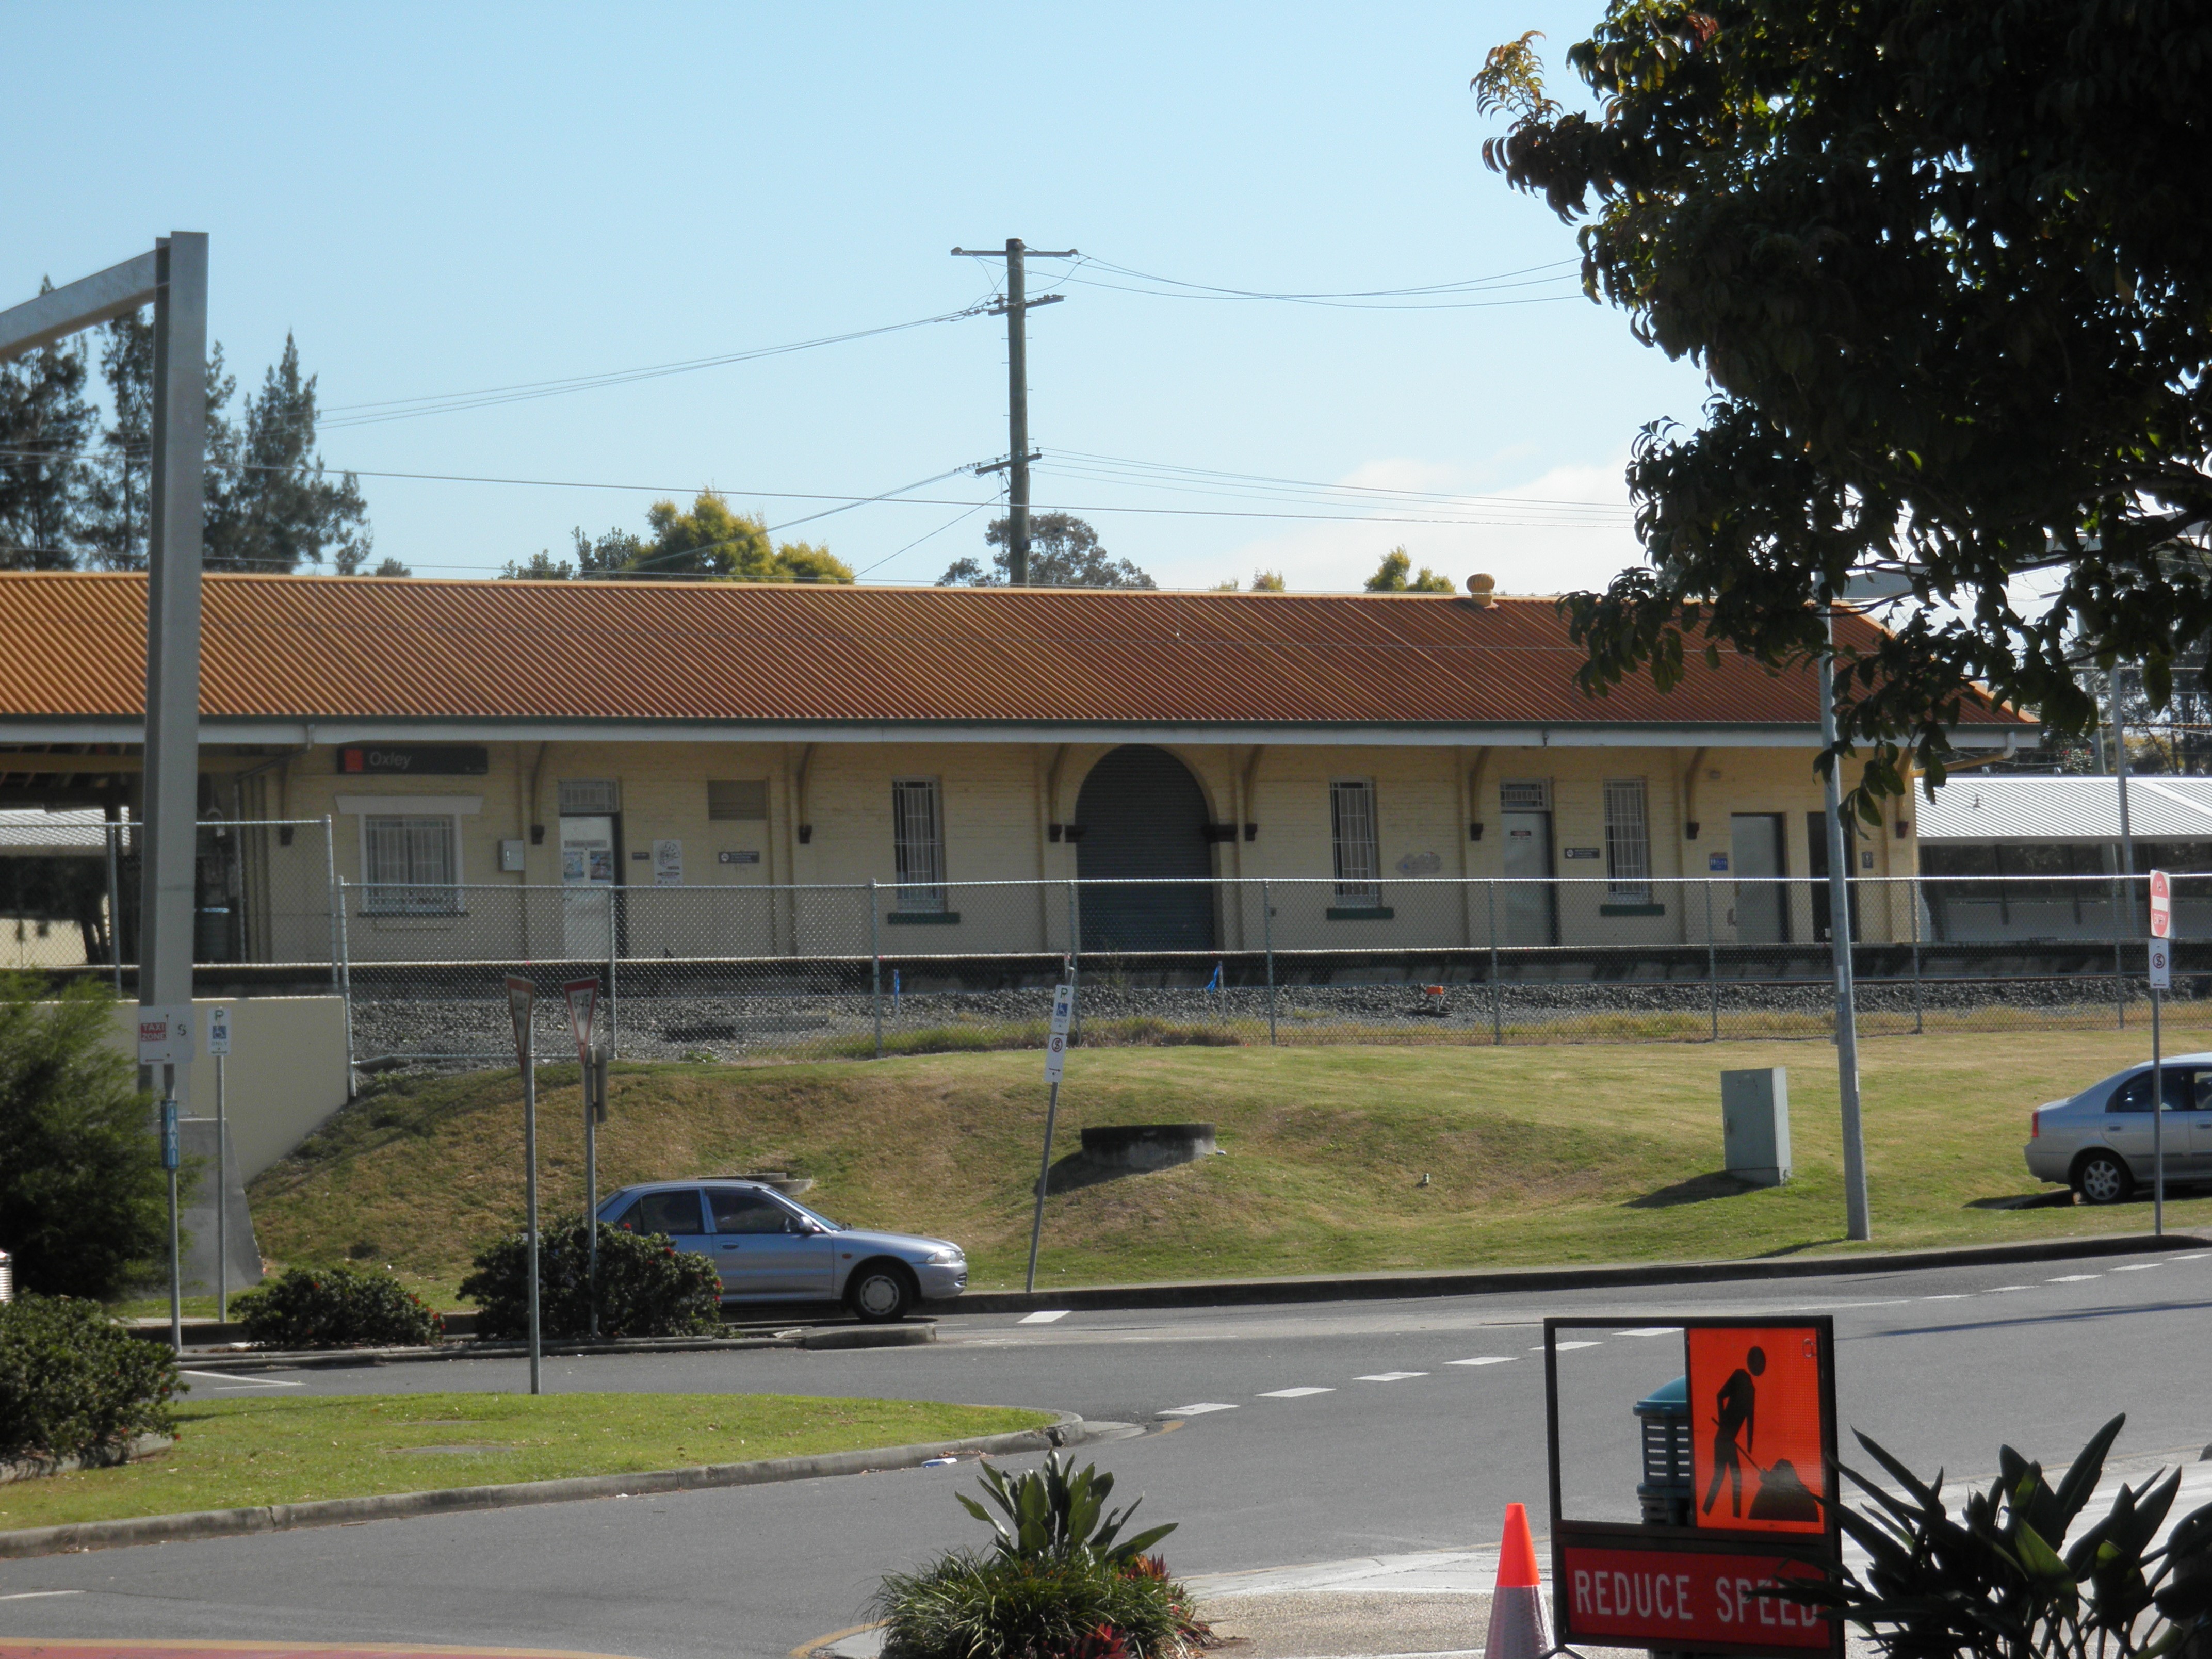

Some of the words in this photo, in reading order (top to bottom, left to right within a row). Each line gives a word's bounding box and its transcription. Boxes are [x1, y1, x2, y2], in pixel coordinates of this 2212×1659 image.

[369, 752, 412, 769] Oxley
[1060, 987, 1068, 998] P
[574, 994, 590, 1010] GIVE
[214, 1009, 224, 1021] P
[143, 1023, 165, 1031] TAXI
[141, 1032, 166, 1041] ZONE
[1574, 1570, 1694, 1619] REDUCE
